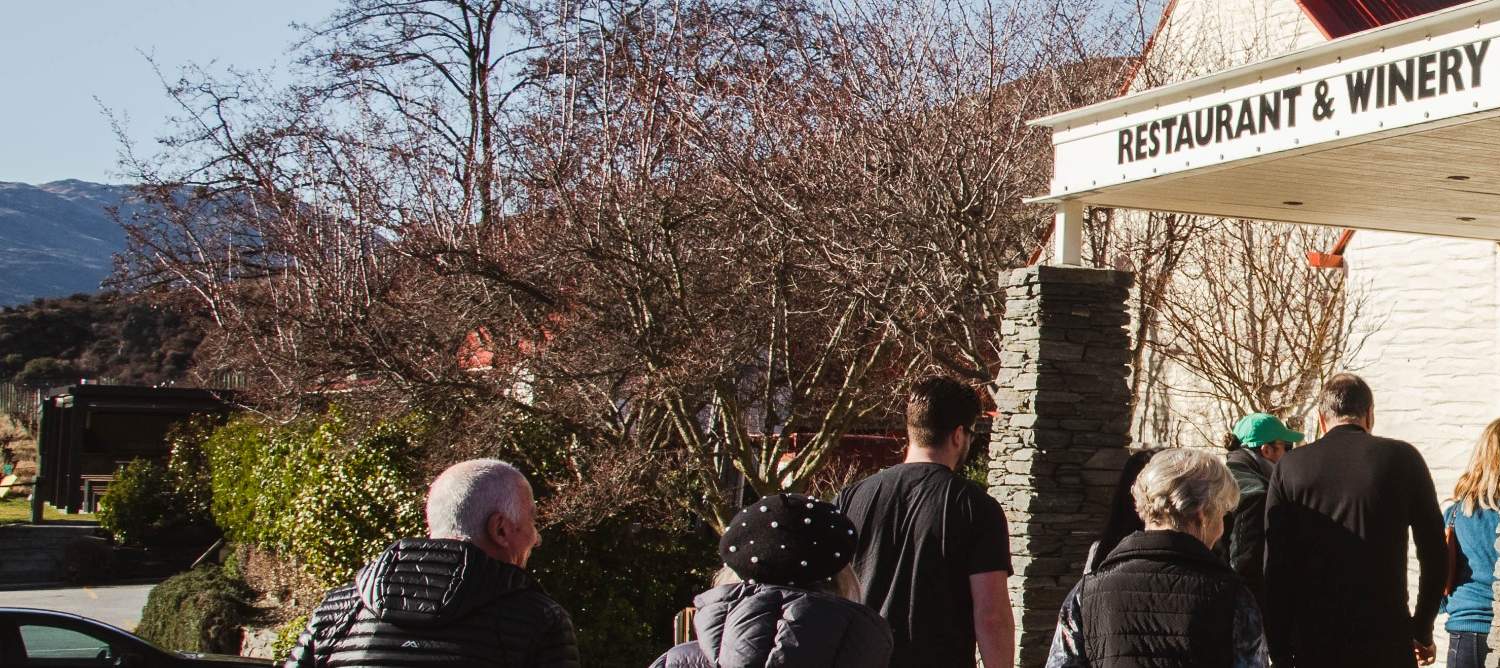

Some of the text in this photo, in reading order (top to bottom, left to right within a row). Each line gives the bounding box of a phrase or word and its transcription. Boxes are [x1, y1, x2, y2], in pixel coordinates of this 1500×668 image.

[1117, 39, 1491, 165] RESTAURANT & WINERY
